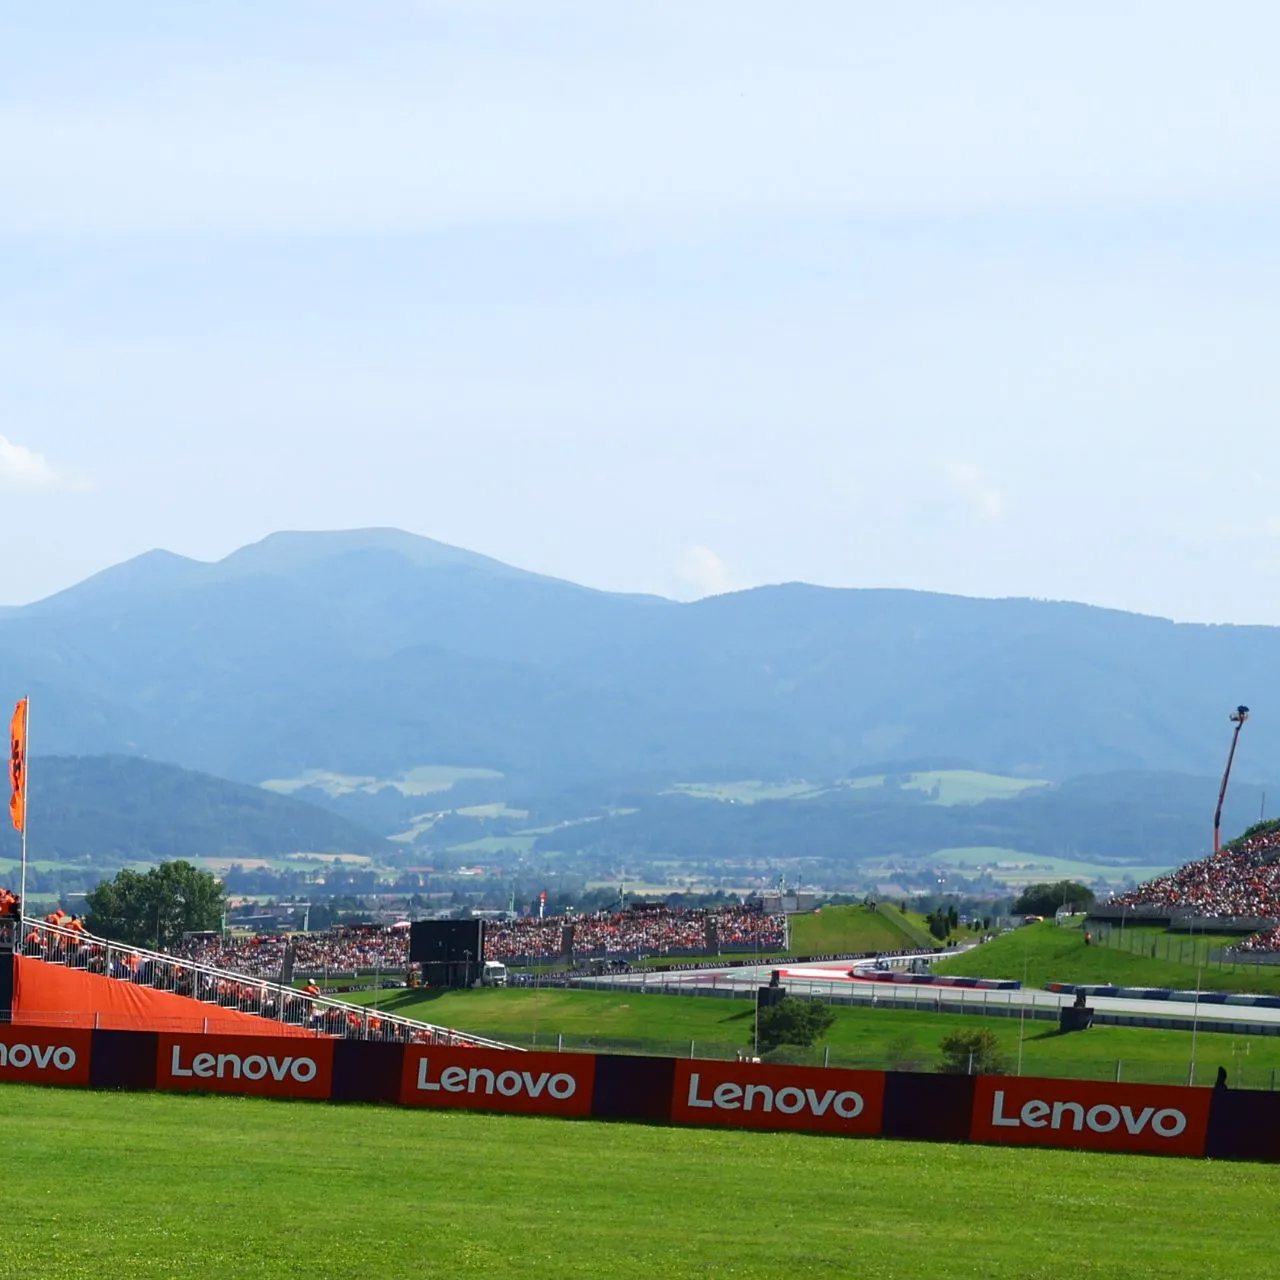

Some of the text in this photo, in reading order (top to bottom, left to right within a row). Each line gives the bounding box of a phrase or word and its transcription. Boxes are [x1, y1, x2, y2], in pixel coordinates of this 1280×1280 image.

[172, 1046, 316, 1081] Lenovo
[418, 1058, 575, 1098] Lenovo
[688, 1074, 863, 1117] Lenovo
[993, 1091, 1185, 1136] Lenovo
